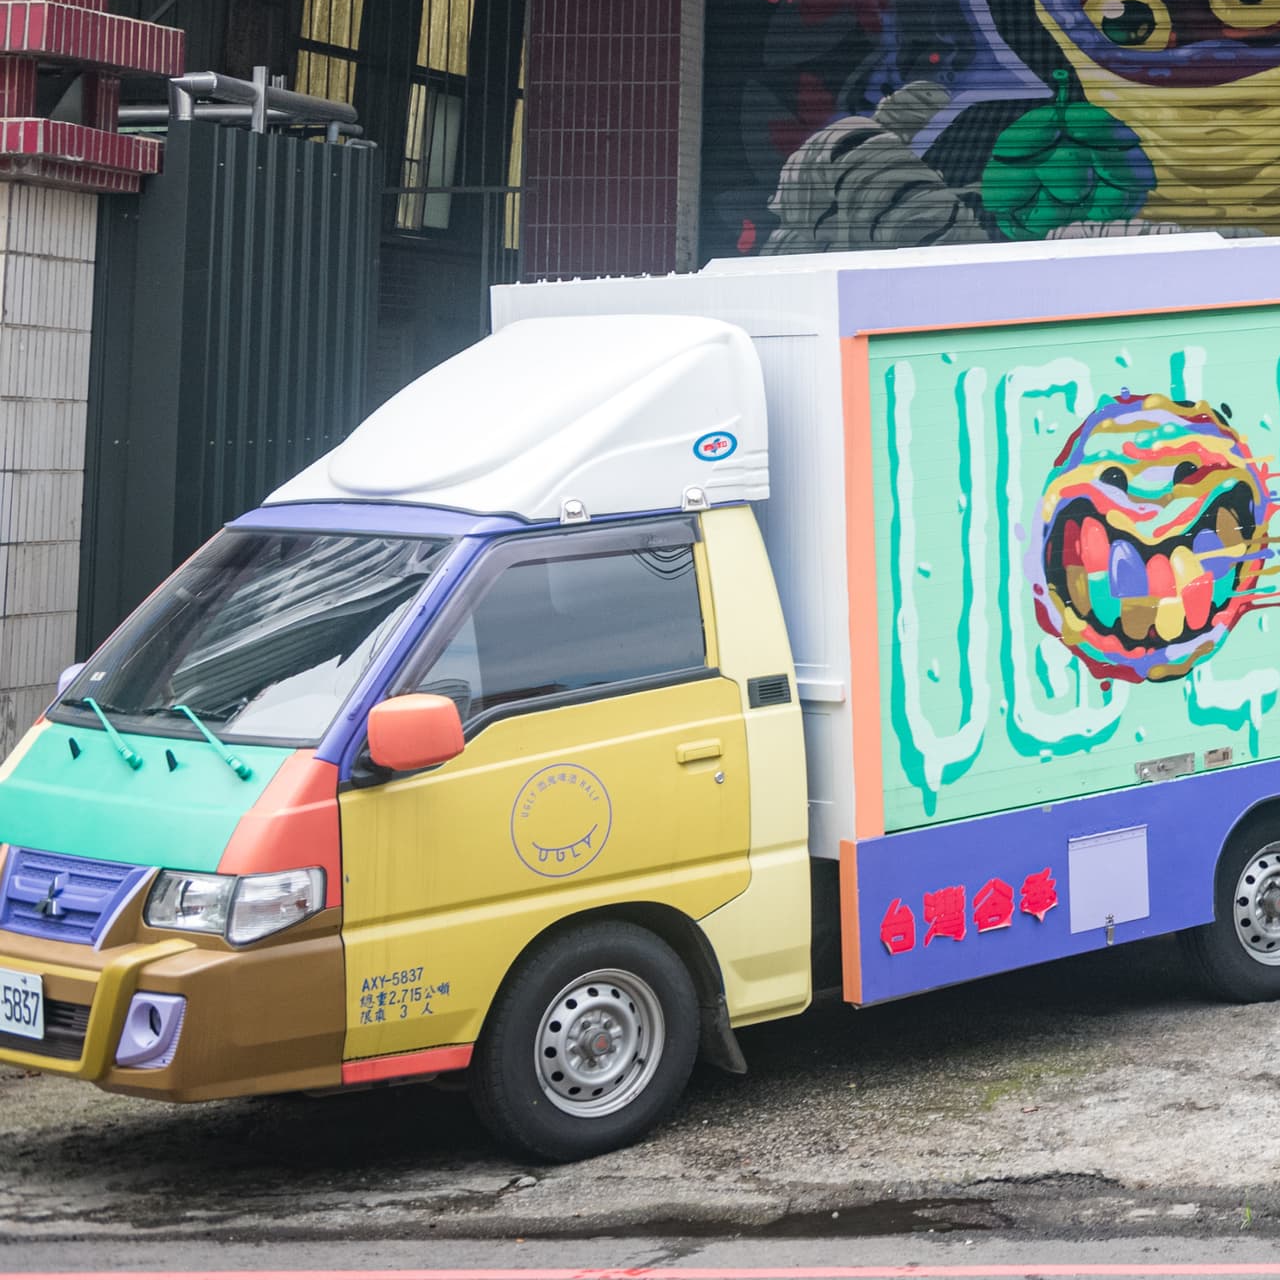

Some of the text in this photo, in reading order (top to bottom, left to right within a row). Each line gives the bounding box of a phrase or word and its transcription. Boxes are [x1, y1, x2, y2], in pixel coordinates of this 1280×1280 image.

[538, 834, 592, 862] UGLY
[362, 967, 424, 992] AXY-5837
[400, 1004, 408, 1019] 3
[421, 1002, 433, 1015] 人
